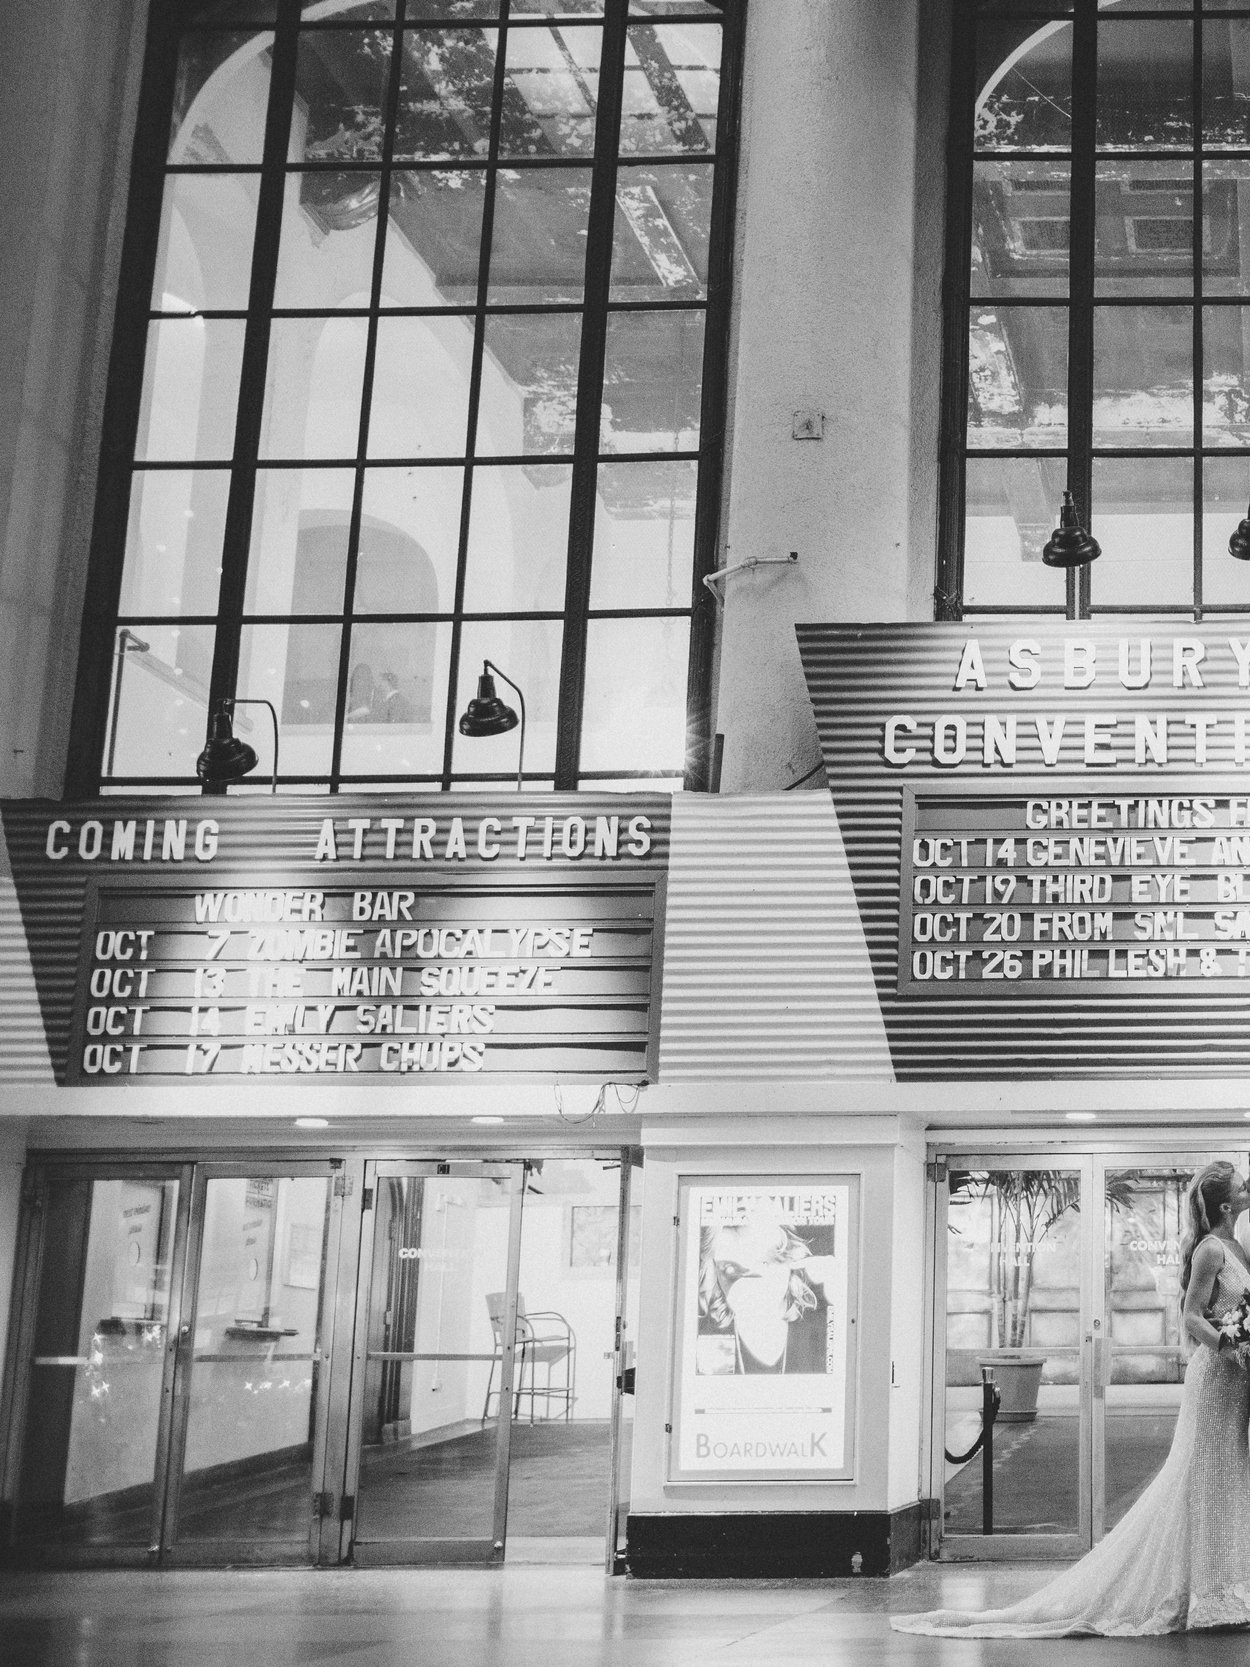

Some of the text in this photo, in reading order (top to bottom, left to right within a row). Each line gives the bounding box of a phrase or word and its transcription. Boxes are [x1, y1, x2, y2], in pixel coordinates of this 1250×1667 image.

[1026, 799, 1215, 829] GREETINGS
[45, 816, 652, 861] COMING ATTRACTIONS
[912, 837, 976, 867] OCT
[986, 837, 1017, 867] 14
[1026, 836, 1196, 866] GENEVIEVE
[914, 875, 978, 904] OCT
[986, 874, 1017, 904] 19
[1027, 874, 1112, 904] THIRD
[1131, 874, 1191, 903] EYE
[195, 891, 416, 924] WONDER BAR
[913, 912, 973, 942] OCT
[982, 912, 1022, 942] 20
[1033, 911, 1113, 941] FROM
[1134, 911, 1199, 941] SNL
[95, 928, 594, 961] OCT 7 ZOMBIE APOCALYPSE
[912, 950, 973, 980] OCT
[982, 950, 1023, 980] 26
[1032, 949, 1100, 979] PHIL
[1108, 948, 1187, 978] LESH
[1199, 948, 1222, 977] &
[90, 966, 562, 998] OCT 13 THE MAIN SQUEEZE
[86, 1004, 496, 1036] OCT 14 EMILY SALIERS
[83, 1041, 486, 1074] OCT 17 MESSER CHUPS
[1129, 1240, 1181, 1251] CONVEN
